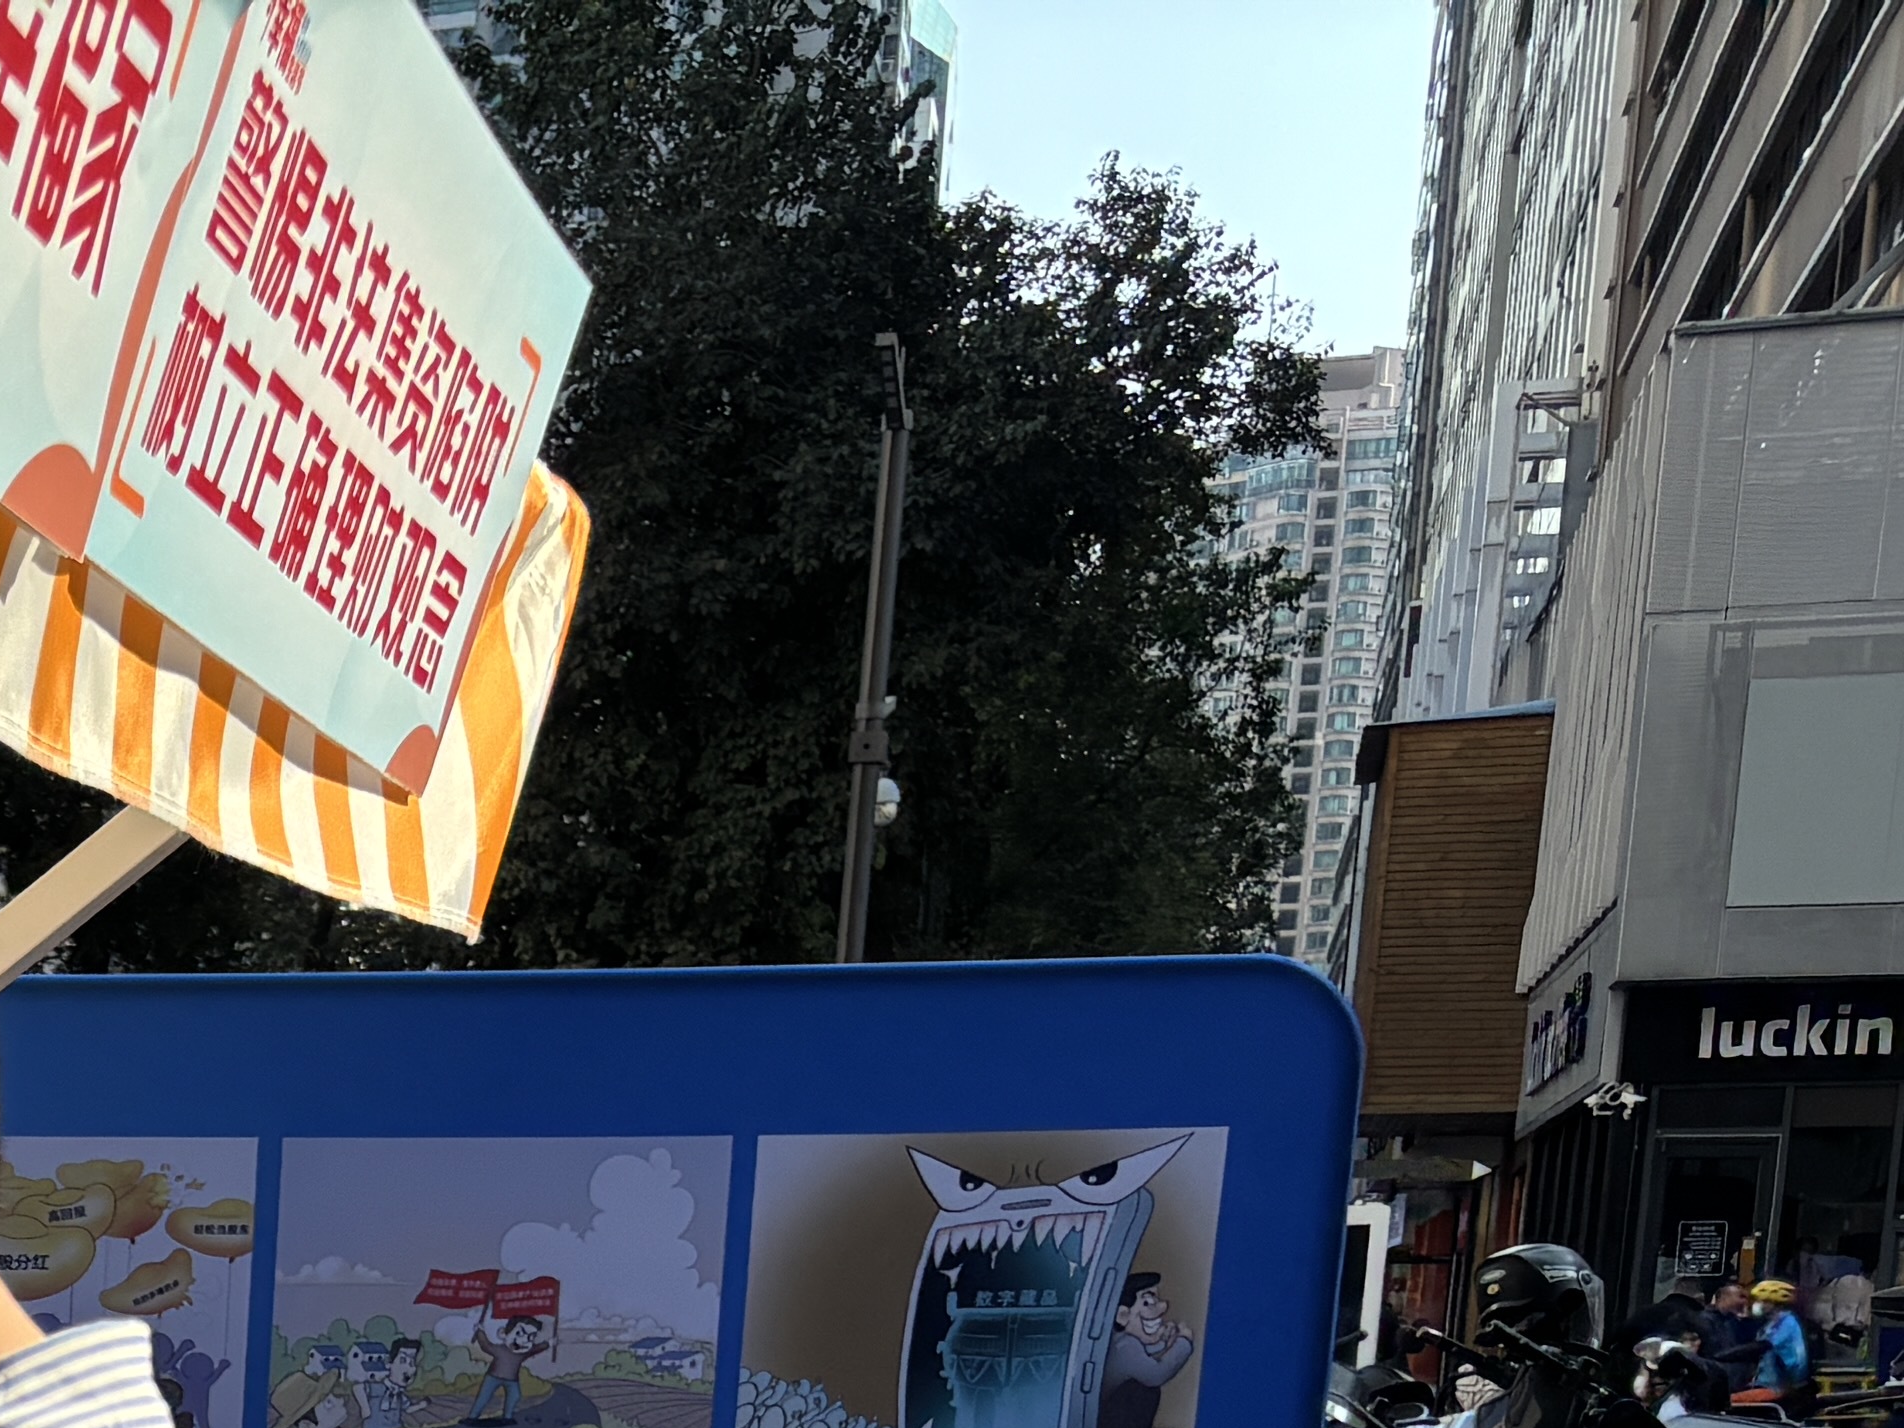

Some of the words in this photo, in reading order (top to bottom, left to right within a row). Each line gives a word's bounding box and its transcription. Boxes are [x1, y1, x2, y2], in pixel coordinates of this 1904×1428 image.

[206, 70, 517, 538] 警惕非法集资陷阱
[140, 283, 468, 696] 树立正确理财观念
[1698, 1004, 1894, 1059] luckin
[974, 1288, 1059, 1308] 数字藏品
